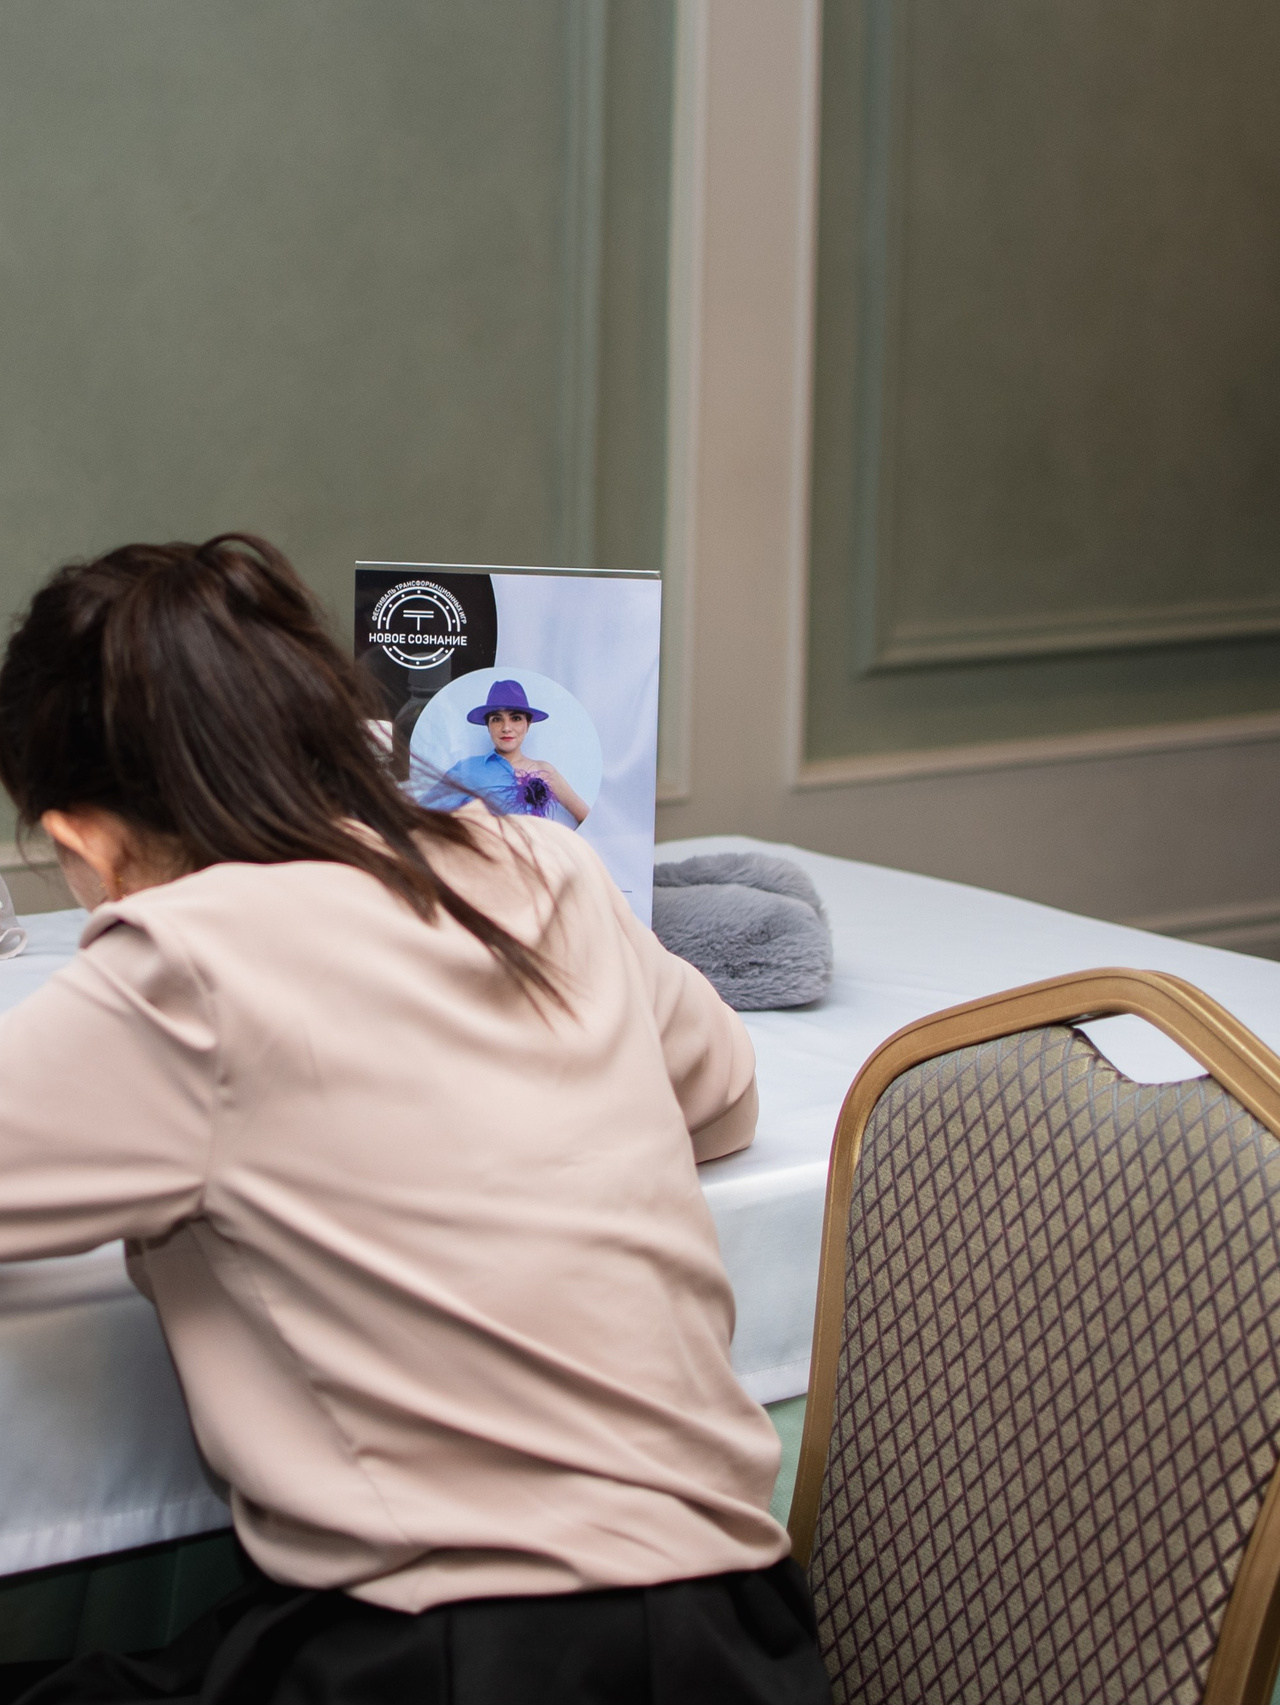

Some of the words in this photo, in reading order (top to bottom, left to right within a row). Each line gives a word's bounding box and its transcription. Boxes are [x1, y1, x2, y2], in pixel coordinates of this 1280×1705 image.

[372, 588, 397, 622] ФЕСТИВАЛЬ
[395, 580, 463, 613] ТРАНСФОРМАЦИОННЫХ
[459, 611, 467, 624] ИГР
[369, 632, 406, 644] НОВОЕ
[407, 634, 467, 646] СОЗНАНИЕ
